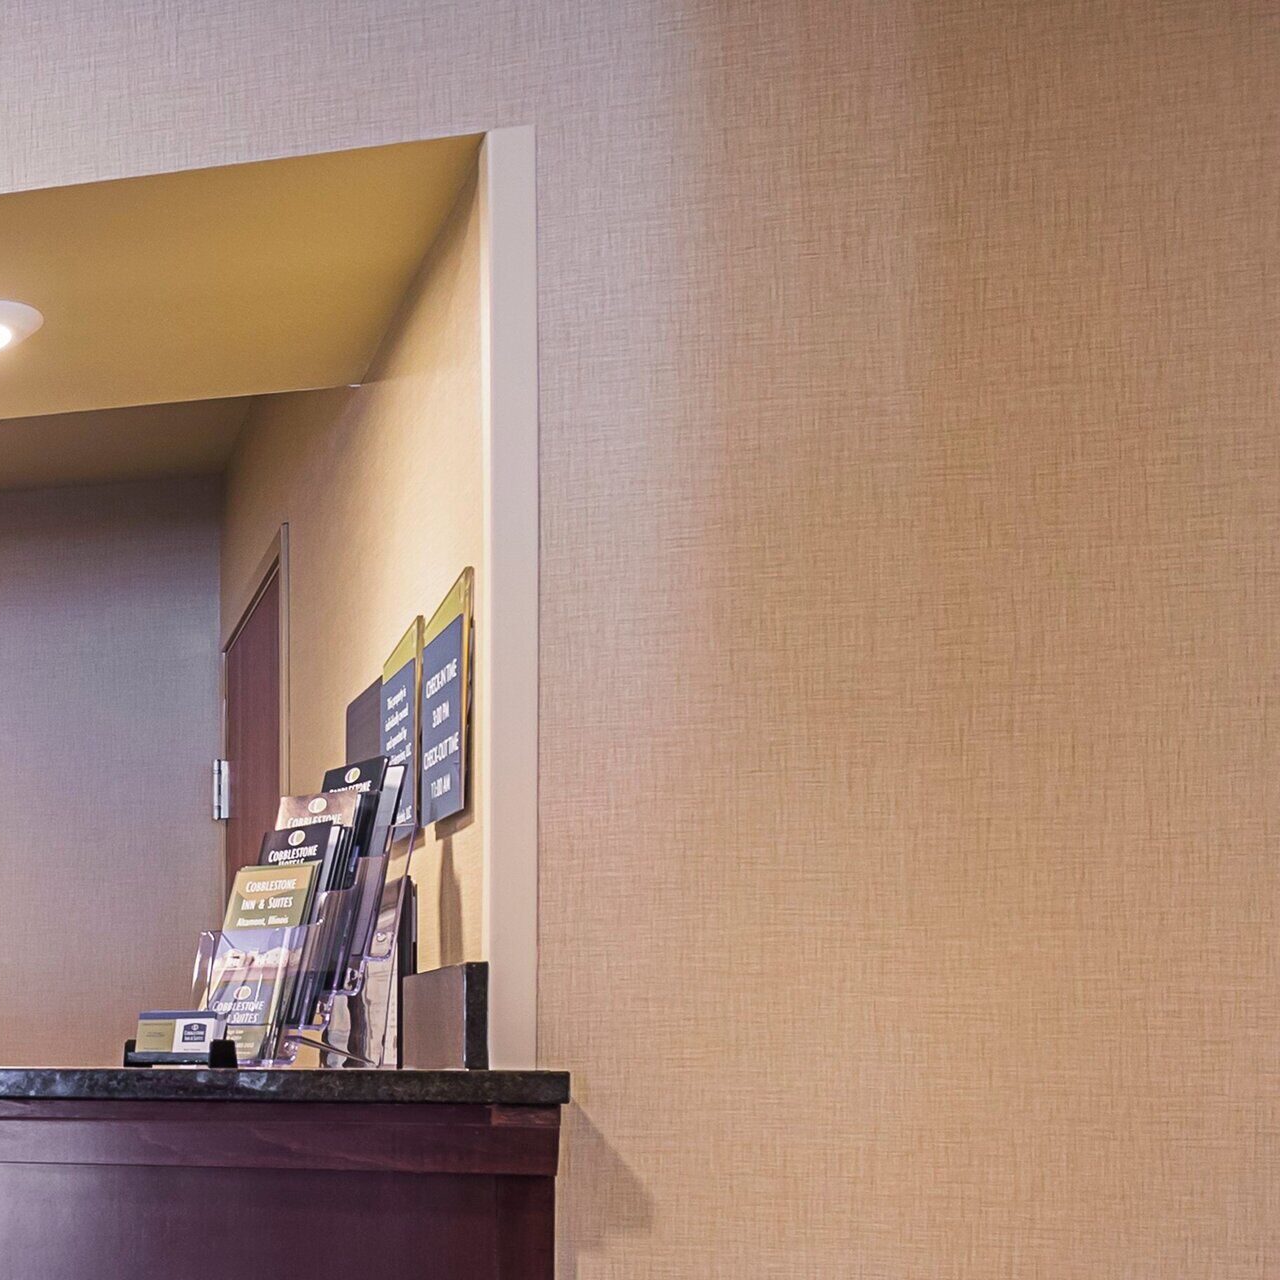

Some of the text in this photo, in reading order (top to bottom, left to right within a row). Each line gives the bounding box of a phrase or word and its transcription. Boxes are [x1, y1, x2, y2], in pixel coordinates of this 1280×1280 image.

[268, 844, 318, 863] COBBLESTONE
[246, 878, 297, 893] COBBLESTONE
[241, 896, 293, 911] INN & SUITES
[231, 1012, 259, 1024] SUITES
